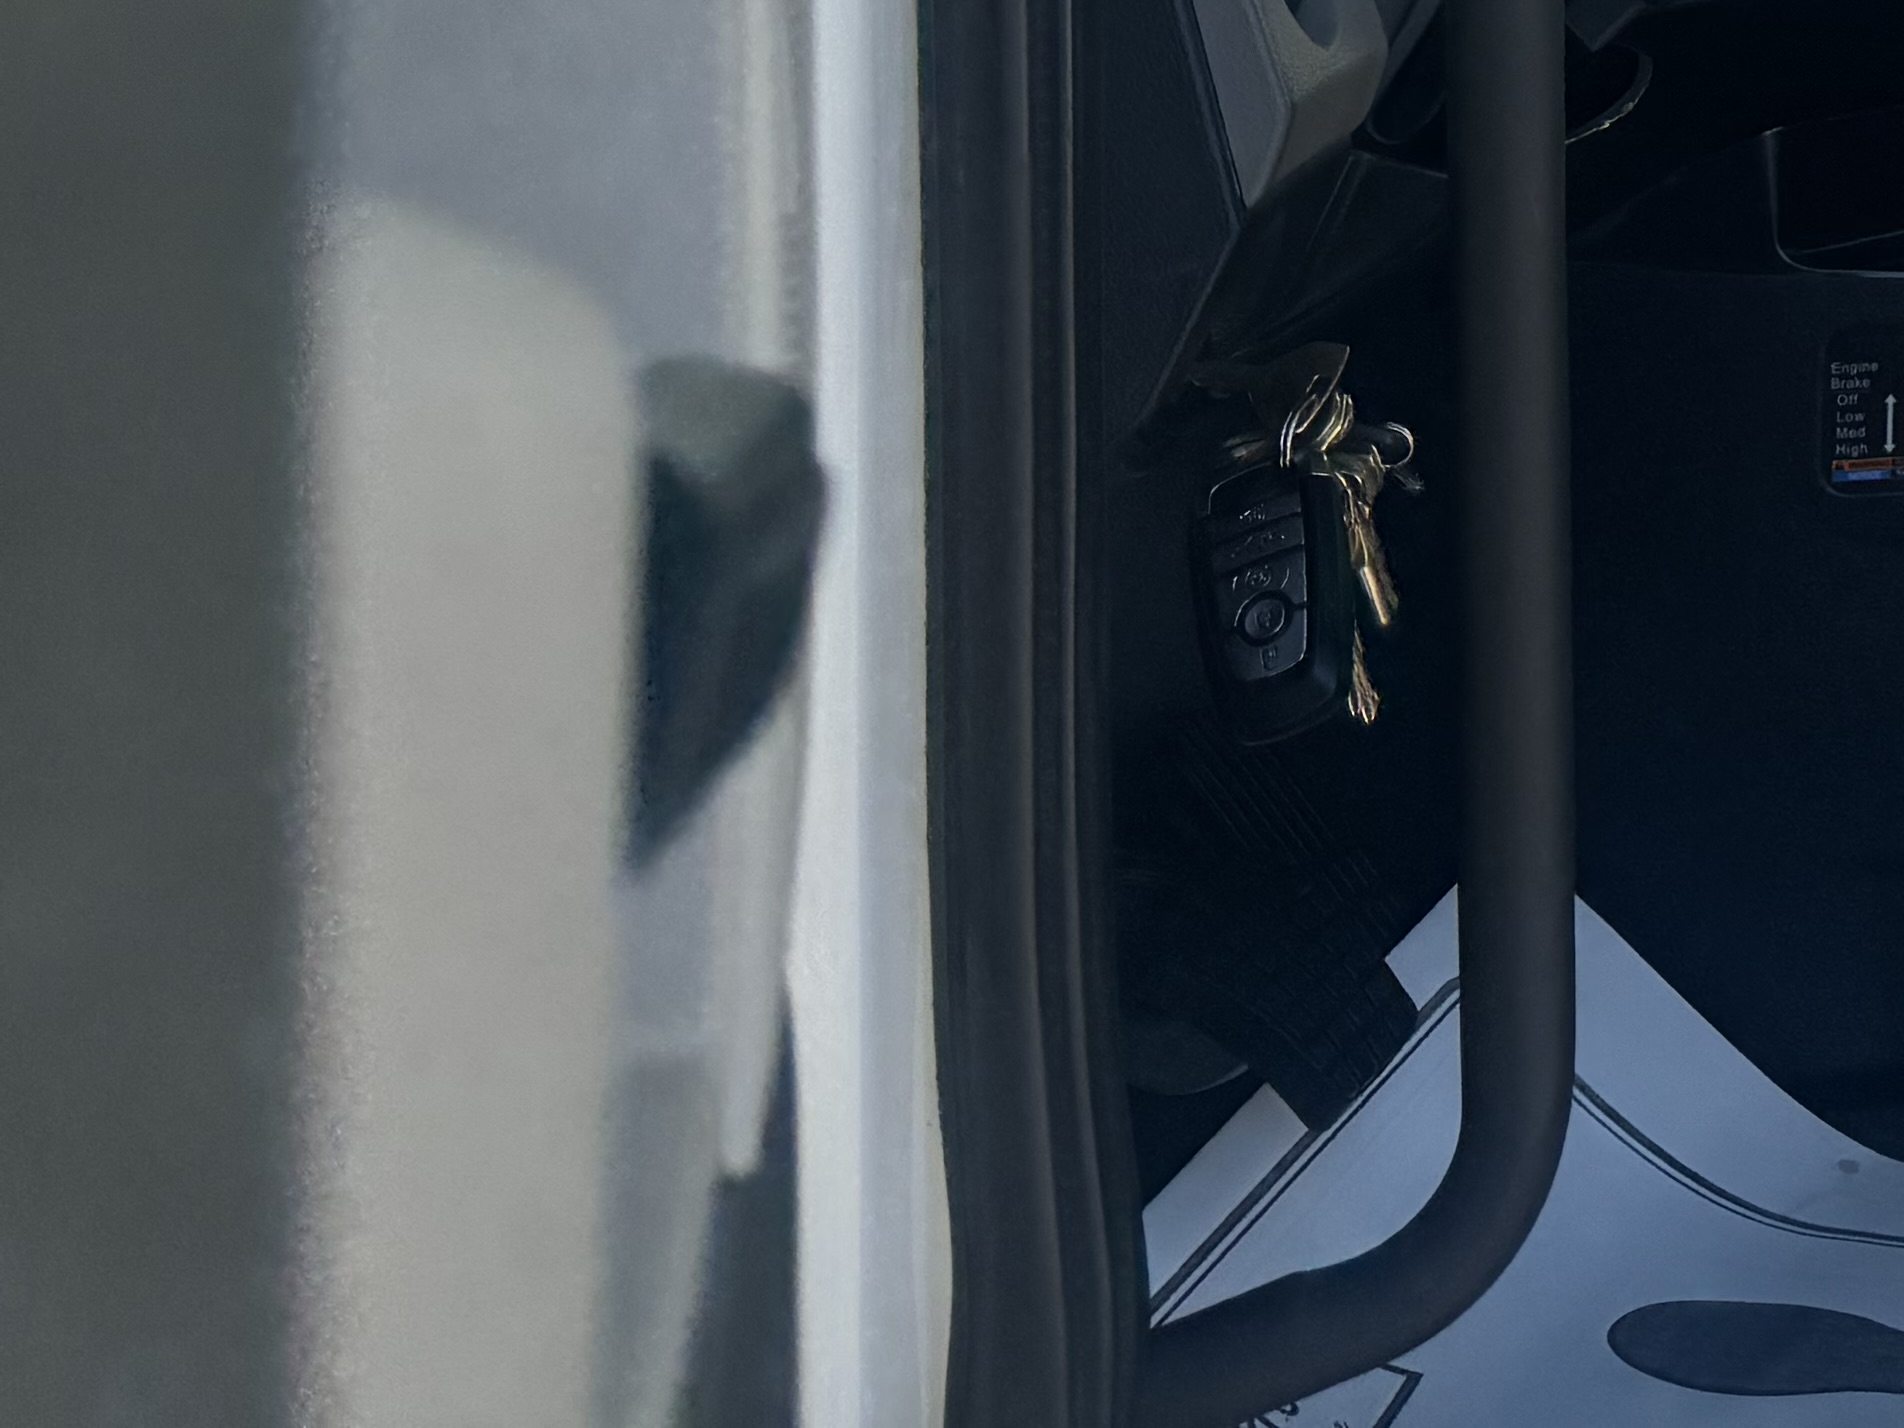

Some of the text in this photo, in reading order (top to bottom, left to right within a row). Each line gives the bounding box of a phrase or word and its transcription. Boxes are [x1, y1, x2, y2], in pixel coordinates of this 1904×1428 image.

[1830, 362, 1879, 376] Engine
[1831, 376, 1872, 390] Brake
[1836, 393, 1859, 407] Off
[1836, 411, 1866, 424] Low
[1836, 426, 1866, 440] Med
[1835, 443, 1869, 457] High
